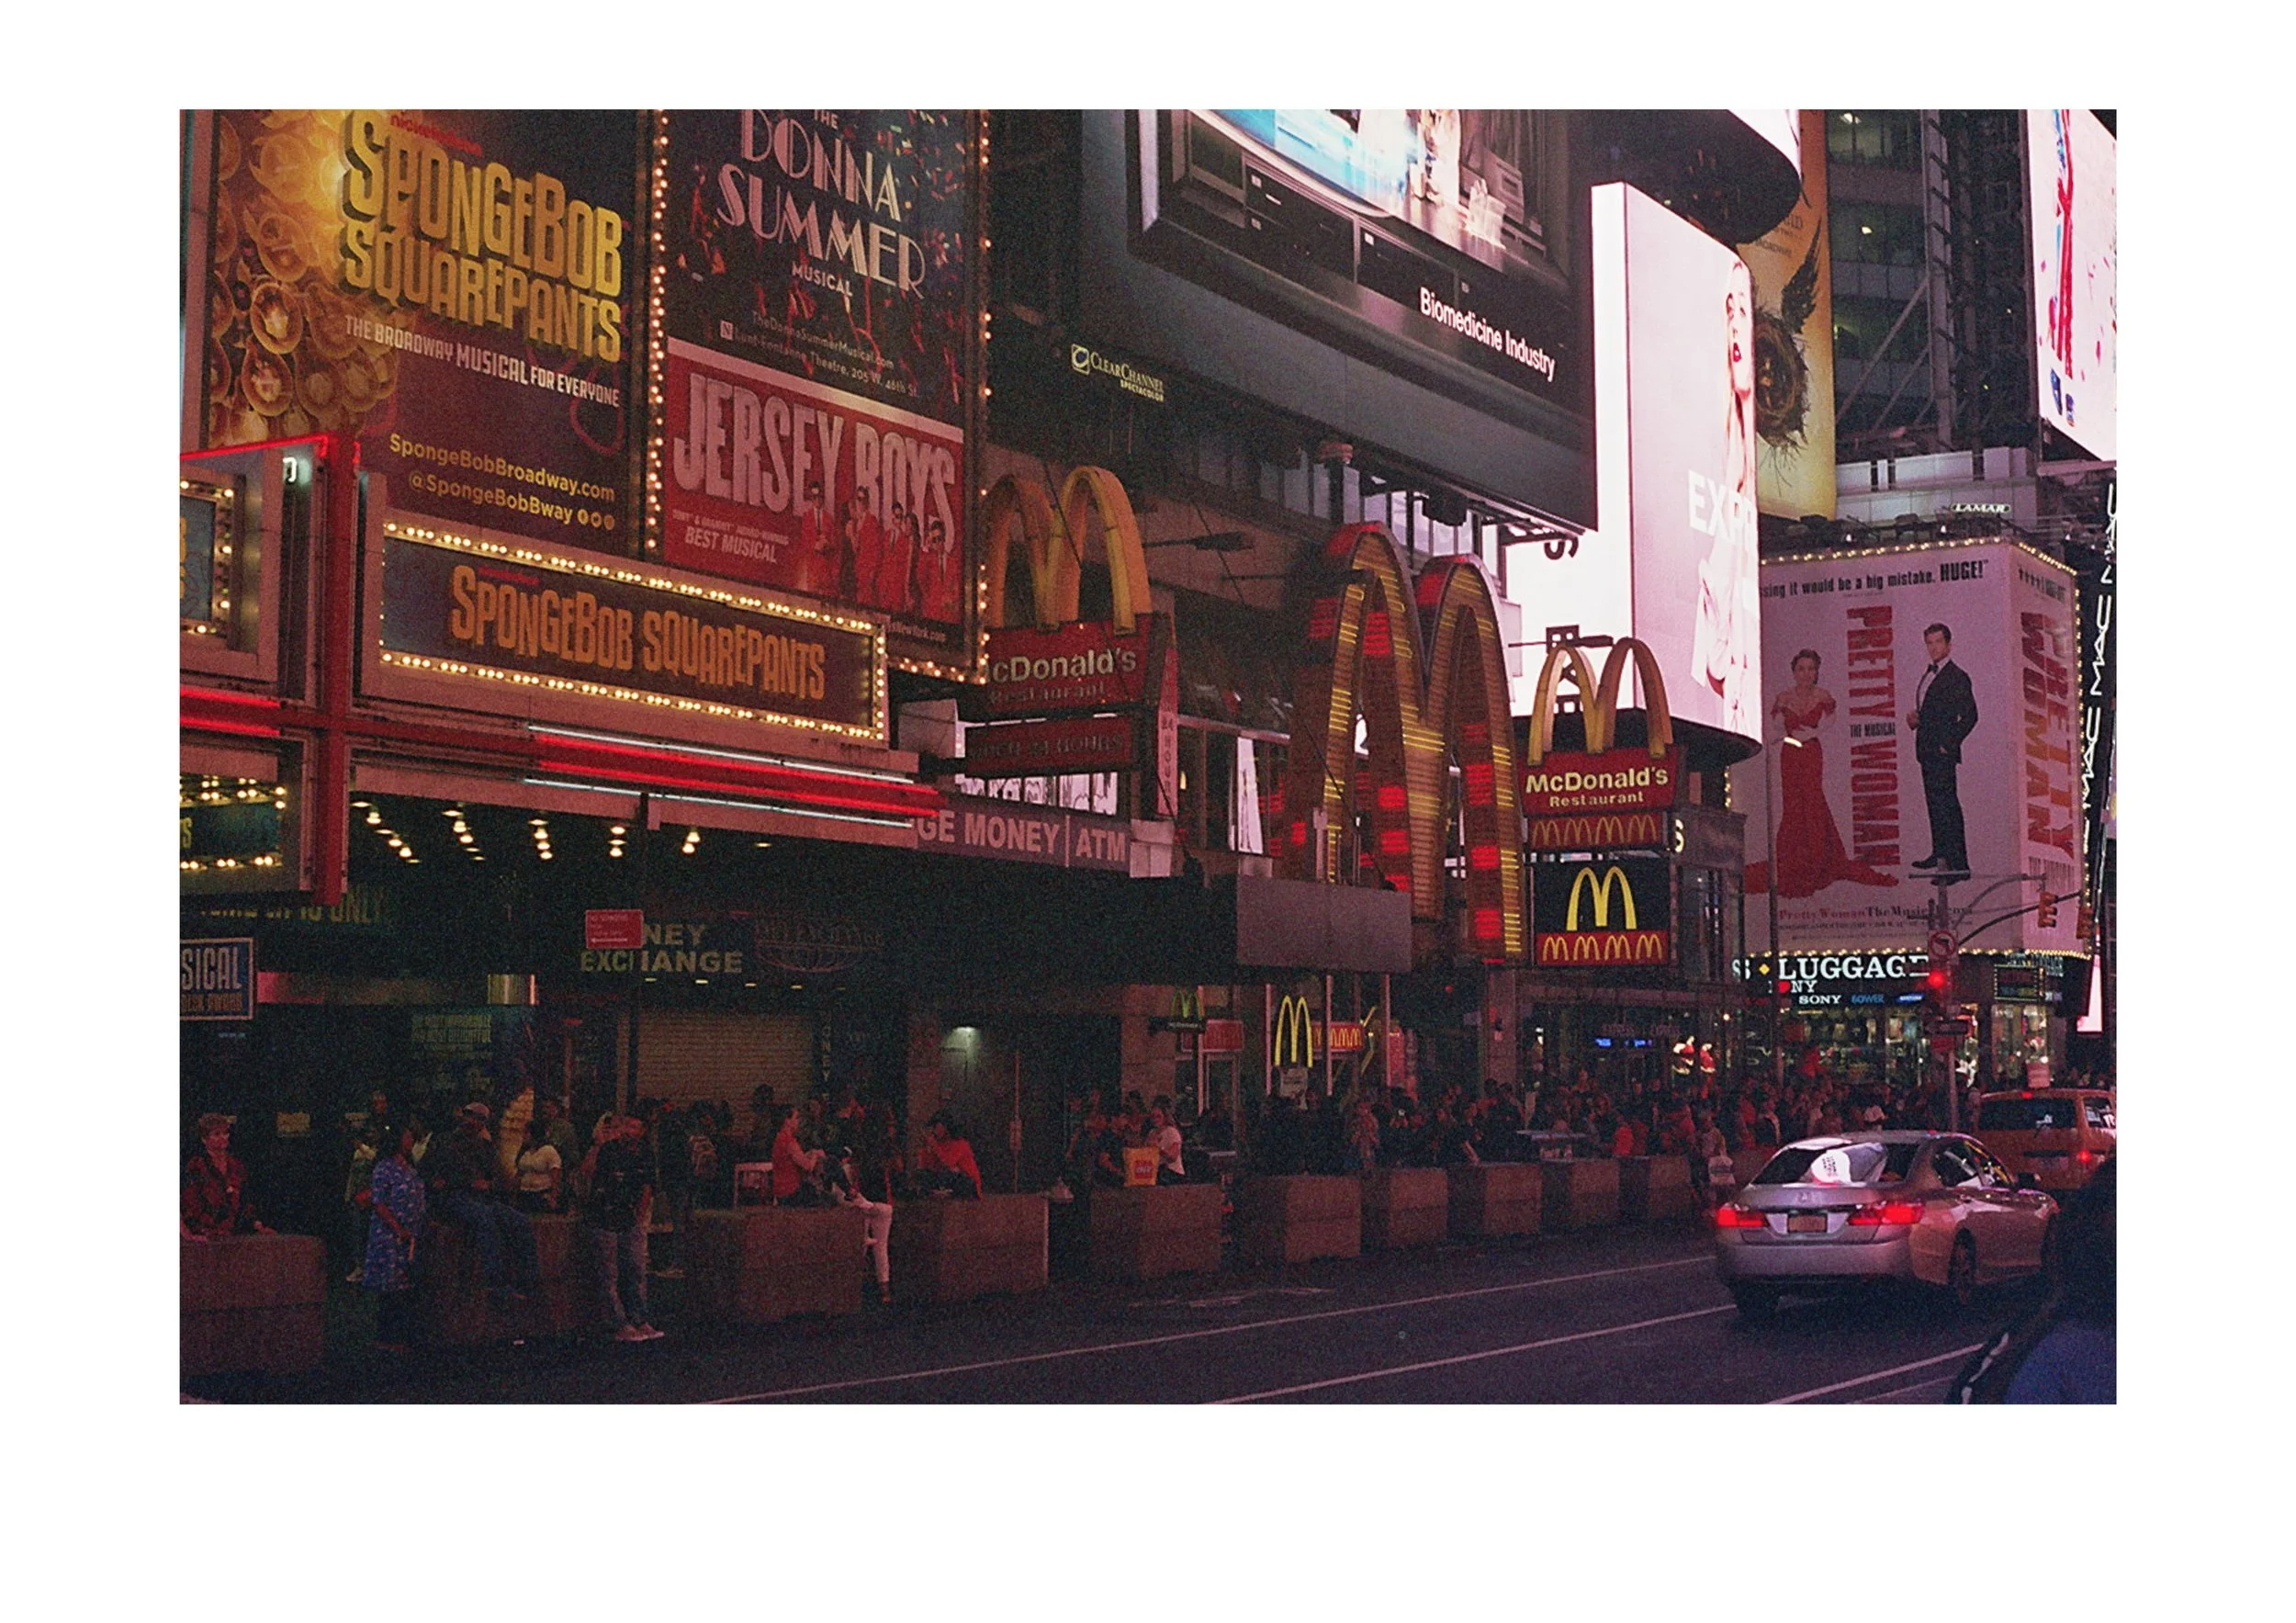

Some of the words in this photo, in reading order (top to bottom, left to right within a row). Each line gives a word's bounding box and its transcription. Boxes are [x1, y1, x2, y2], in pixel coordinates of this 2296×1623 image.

[740, 109, 901, 222] DONNA
[344, 108, 623, 297] SPONGEBOB
[716, 163, 925, 299] SUMMER
[345, 220, 622, 364] SQUAREPANTS
[792, 261, 853, 297] MUSICAL
[1420, 287, 1503, 351] Biomedicine
[1504, 330, 1556, 382] Industry
[345, 316, 372, 343] THE
[374, 325, 455, 366] BROADWAY
[456, 345, 529, 386] MUSICAL
[531, 365, 554, 390] FOR
[557, 376, 620, 409] EVERYONE
[388, 432, 616, 502] SpongeBobBroadway.com
[673, 372, 844, 513] JERSEY
[854, 419, 956, 553] BOYS
[410, 471, 572, 525] @SpongeBobBway
[1953, 502, 2009, 514] LAMAR
[684, 525, 720, 550] BEST
[721, 534, 777, 563] MUSICAL
[1789, 580, 1798, 594] it
[1801, 578, 1835, 594] would
[1838, 576, 1851, 592] be
[1855, 579, 1863, 591] a
[1866, 573, 1885, 592] big
[1887, 570, 1936, 588] mistake.
[451, 565, 634, 671] SPONGEBOB
[641, 609, 826, 702] SQUAREPANTS
[992, 648, 1138, 683] cDonald's
[1846, 604, 1896, 718] PRETTY
[1850, 722, 1862, 738] THE
[1863, 721, 1897, 738] MUSICAL
[2020, 613, 2051, 846] WOMAN
[1526, 766, 1670, 794] McDonald's
[1549, 790, 1645, 808] Restaurant
[1851, 739, 1901, 866] WOMAN
[917, 810, 956, 843] GE
[964, 812, 1060, 854] MONEY
[1075, 828, 1126, 862] ATM
[642, 923, 707, 946] NEY
[181, 947, 242, 991] SICAL
[1791, 979, 1818, 994] NY
[1798, 994, 1842, 1006] SONY
